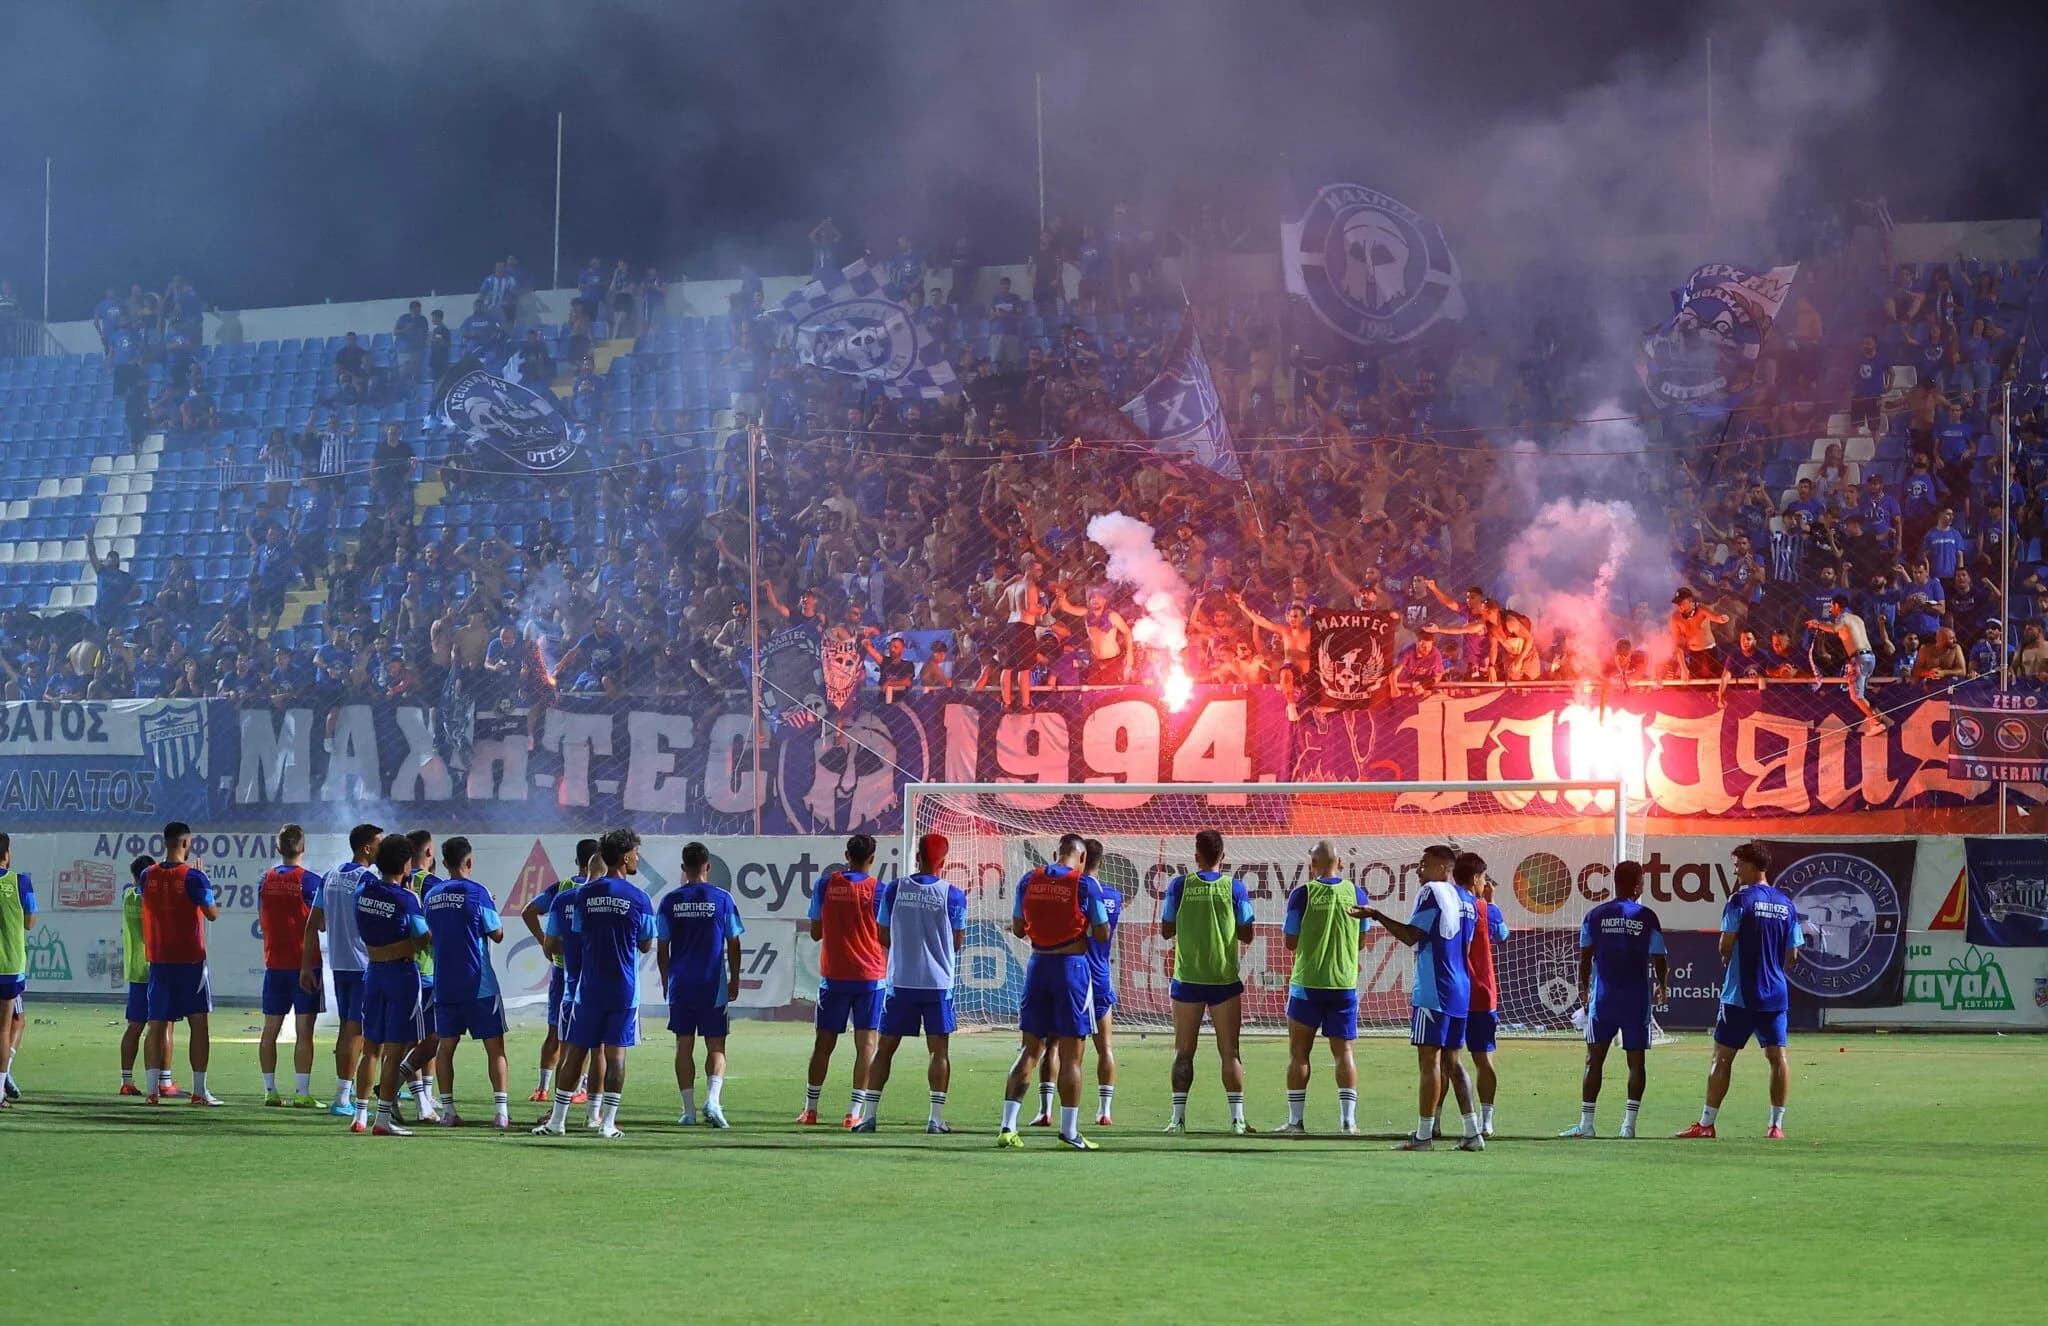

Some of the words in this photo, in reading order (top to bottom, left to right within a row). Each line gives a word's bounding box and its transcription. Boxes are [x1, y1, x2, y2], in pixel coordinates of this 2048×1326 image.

[1316, 615, 1389, 635] MAXHTEC
[1993, 695, 2038, 709] ZERO
[358, 895, 396, 913] ANORTHOSIS
[429, 893, 465, 904] ANORTHOSIS
[586, 896, 631, 909] ANORTHOSIS
[673, 903, 715, 912] ANORTHOSIS
[1601, 918, 1643, 929] ANORTHOSIS
[1675, 963, 1692, 979] of
